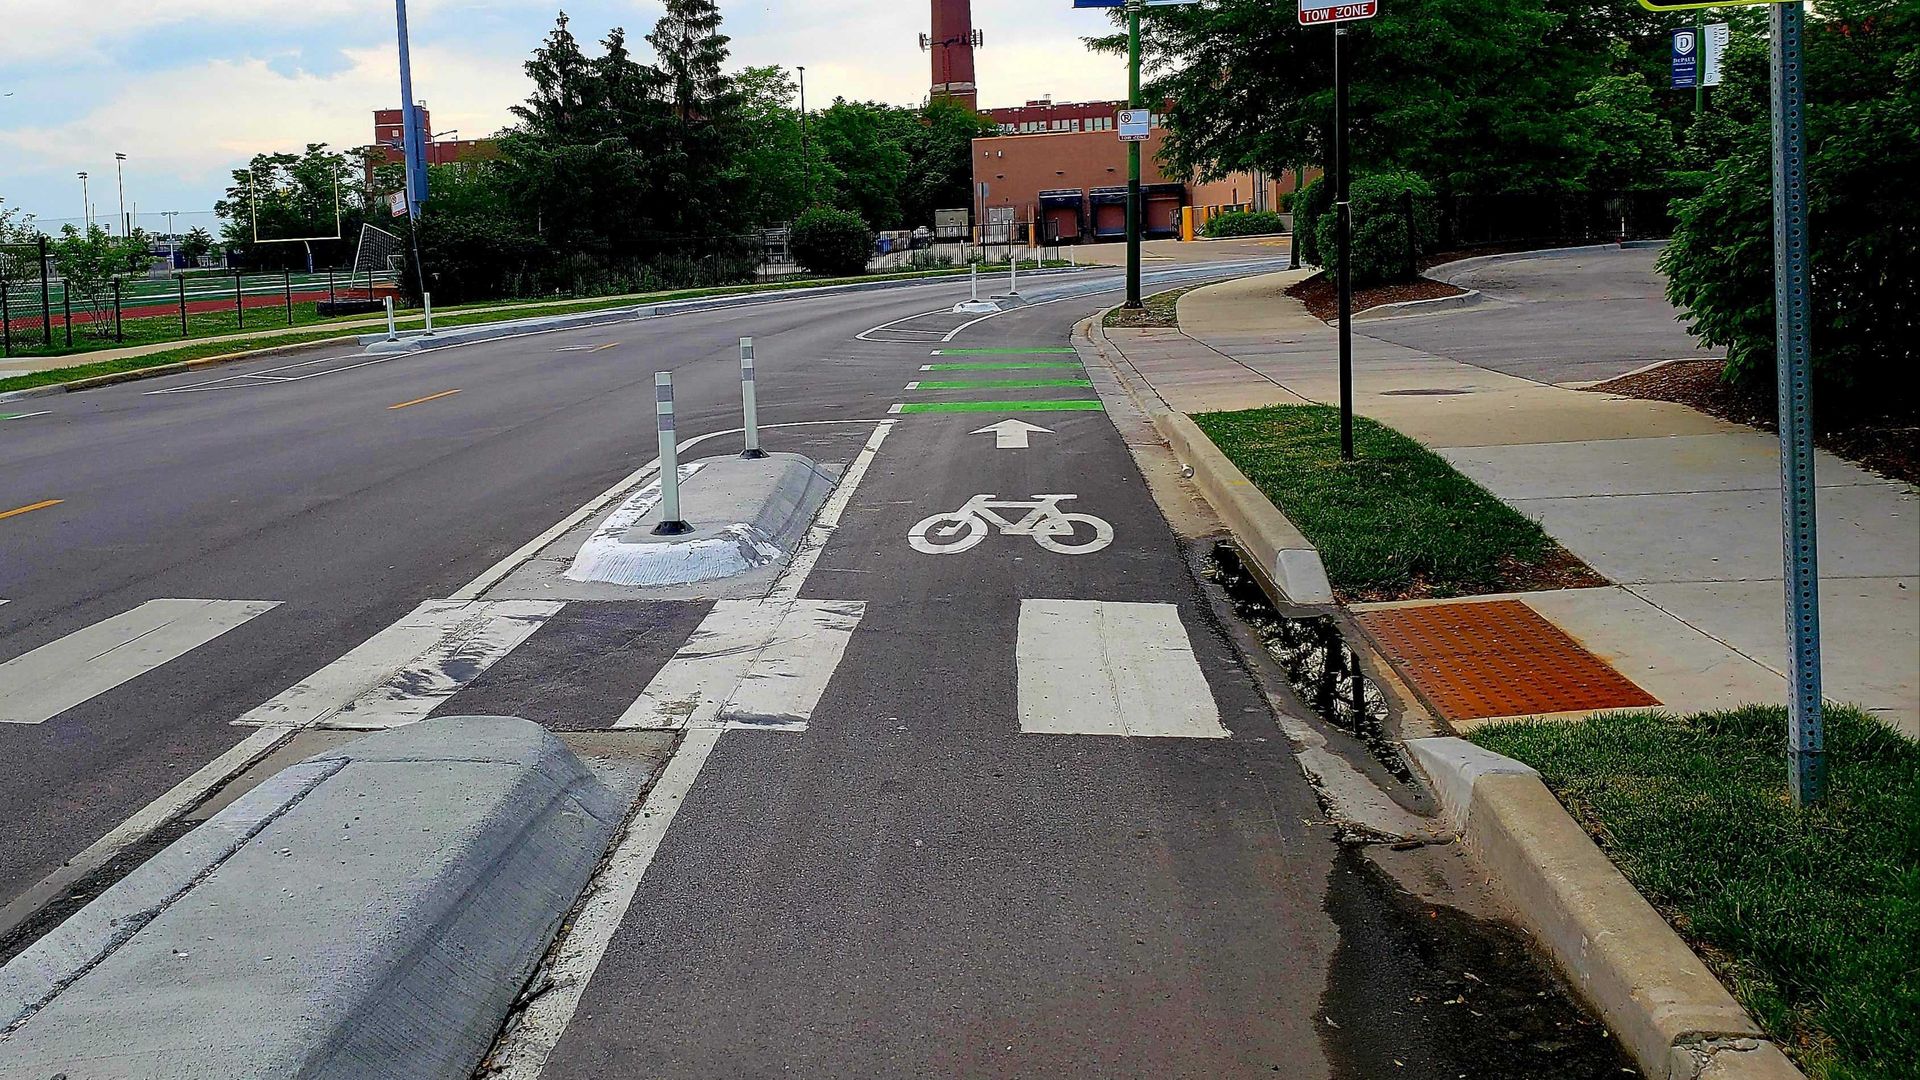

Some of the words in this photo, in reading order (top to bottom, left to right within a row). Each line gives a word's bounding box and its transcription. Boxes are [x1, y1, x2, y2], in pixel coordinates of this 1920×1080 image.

[1304, 9, 1330, 22] TOW
[1335, 4, 1369, 18] ZONE
[1679, 37, 1689, 48] D
